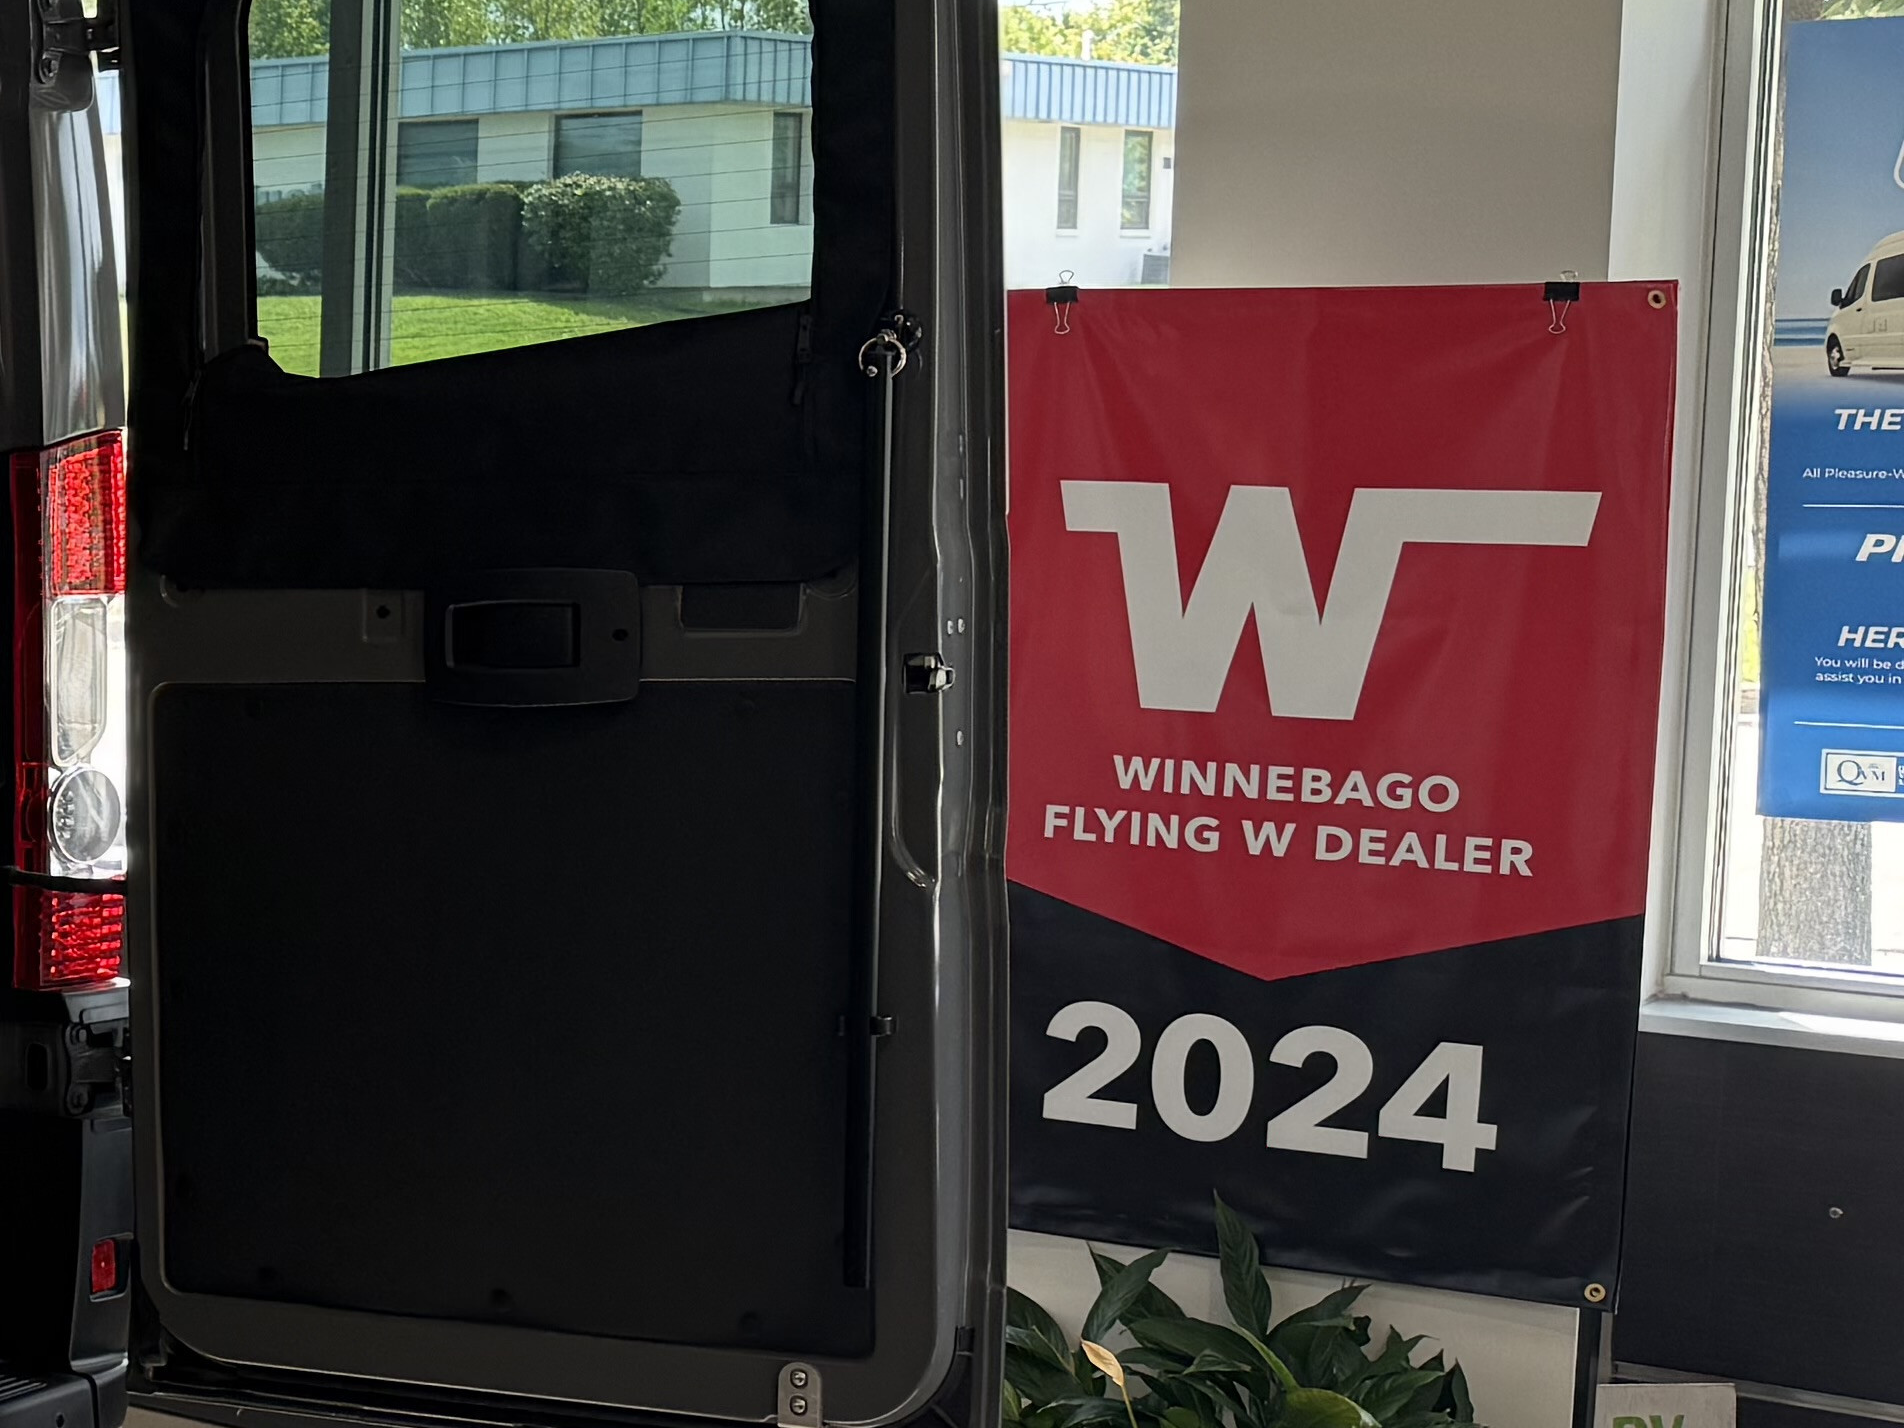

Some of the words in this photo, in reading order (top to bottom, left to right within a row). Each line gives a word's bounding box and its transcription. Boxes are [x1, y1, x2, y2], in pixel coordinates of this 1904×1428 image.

[1834, 408, 1904, 431] THE
[1802, 467, 1821, 479] All
[1059, 479, 1603, 721] W
[1815, 657, 1841, 668] You
[1844, 658, 1869, 669] will
[1873, 658, 1892, 670] be
[1815, 672, 1854, 683] assist
[1857, 674, 1885, 685] you
[1888, 673, 1902, 684] in
[1113, 754, 1460, 813] WINNEBAGO
[1043, 804, 1221, 853] FLYING
[1241, 819, 1297, 858] W
[1315, 824, 1534, 877] DEALER
[1042, 1000, 1498, 1173] 2024
